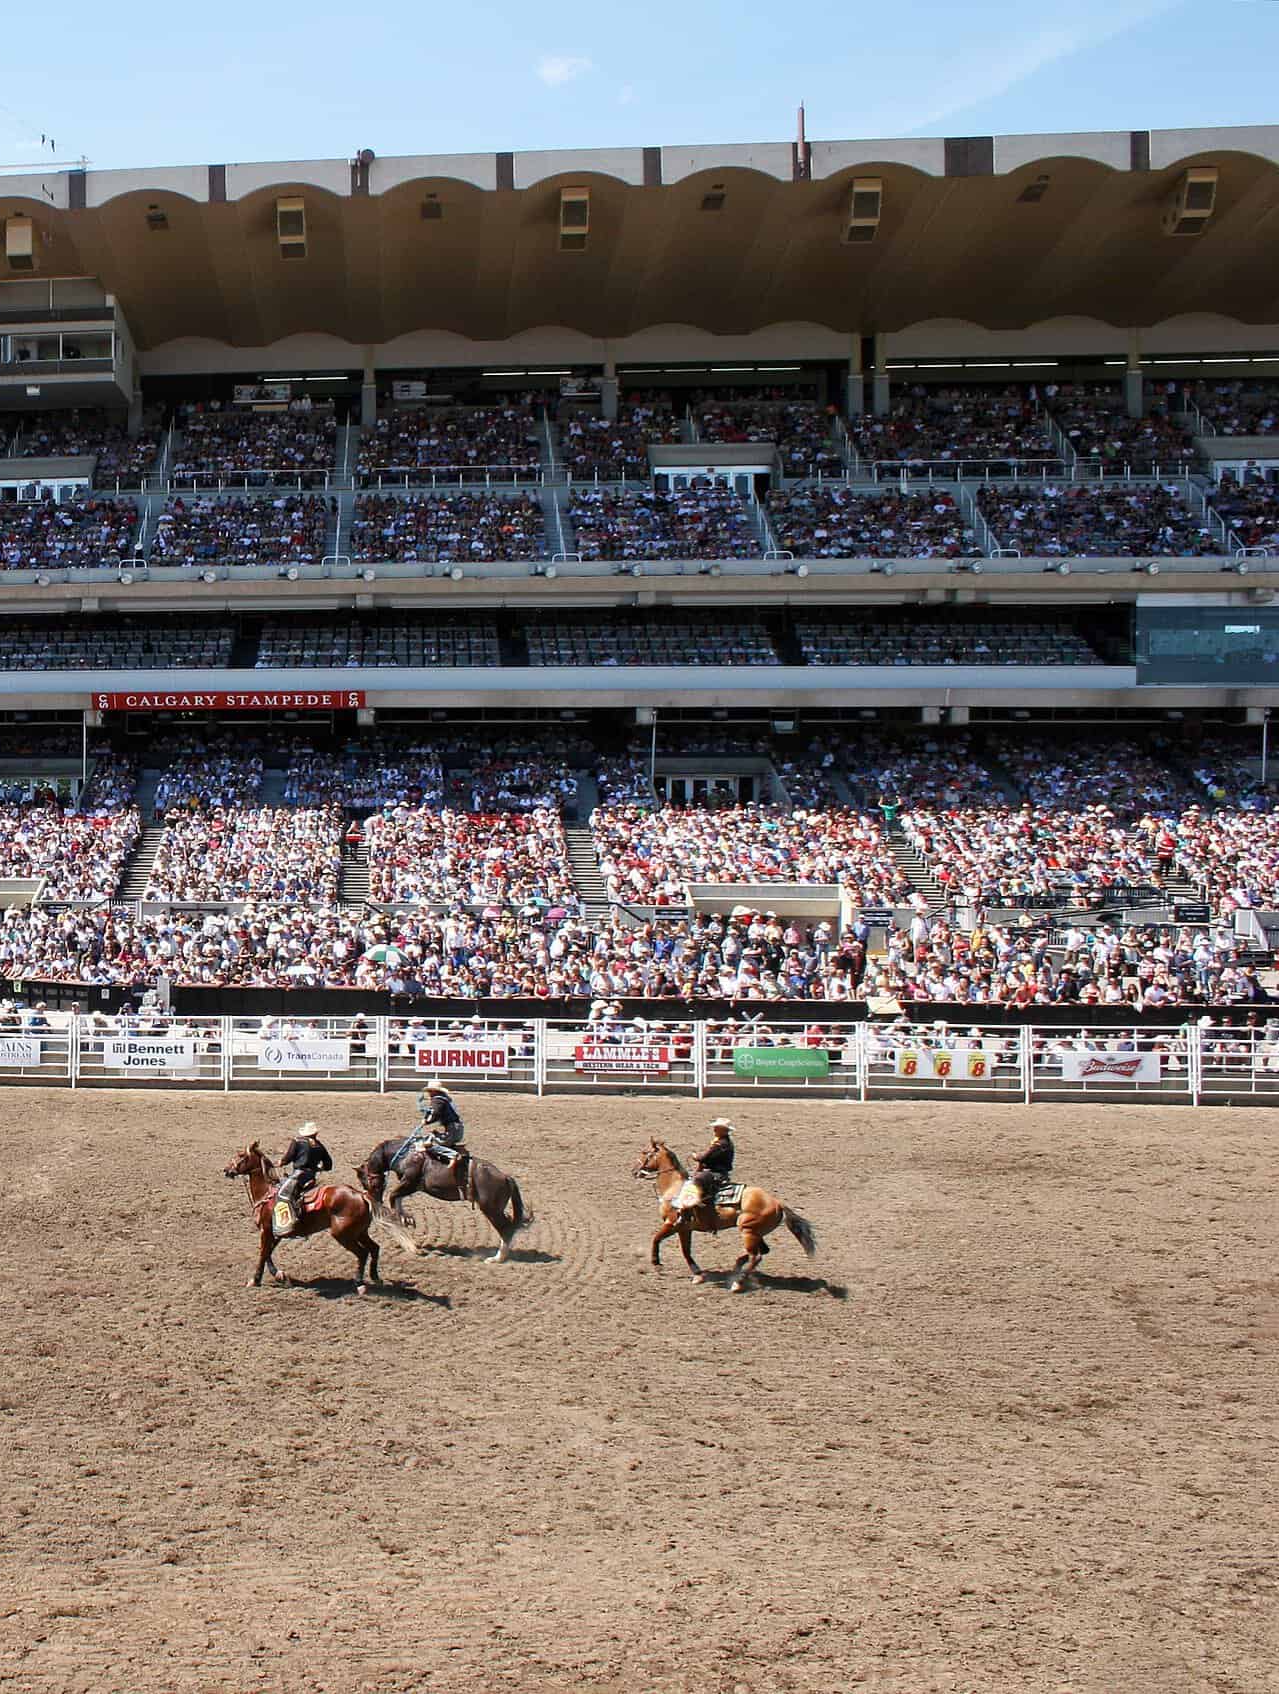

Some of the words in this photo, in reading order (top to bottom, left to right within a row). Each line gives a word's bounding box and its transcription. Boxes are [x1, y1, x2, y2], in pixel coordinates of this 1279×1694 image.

[126, 695, 217, 707] CALGARY
[226, 694, 333, 706] STAMPEDE
[128, 1043, 185, 1054] Bennett
[123, 1055, 167, 1066] Jones
[287, 1051, 344, 1060] TransCanada
[418, 1049, 505, 1068] BURNCO
[904, 1060, 917, 1075] 8
[938, 1061, 952, 1076] 8
[972, 1062, 985, 1077] 8
